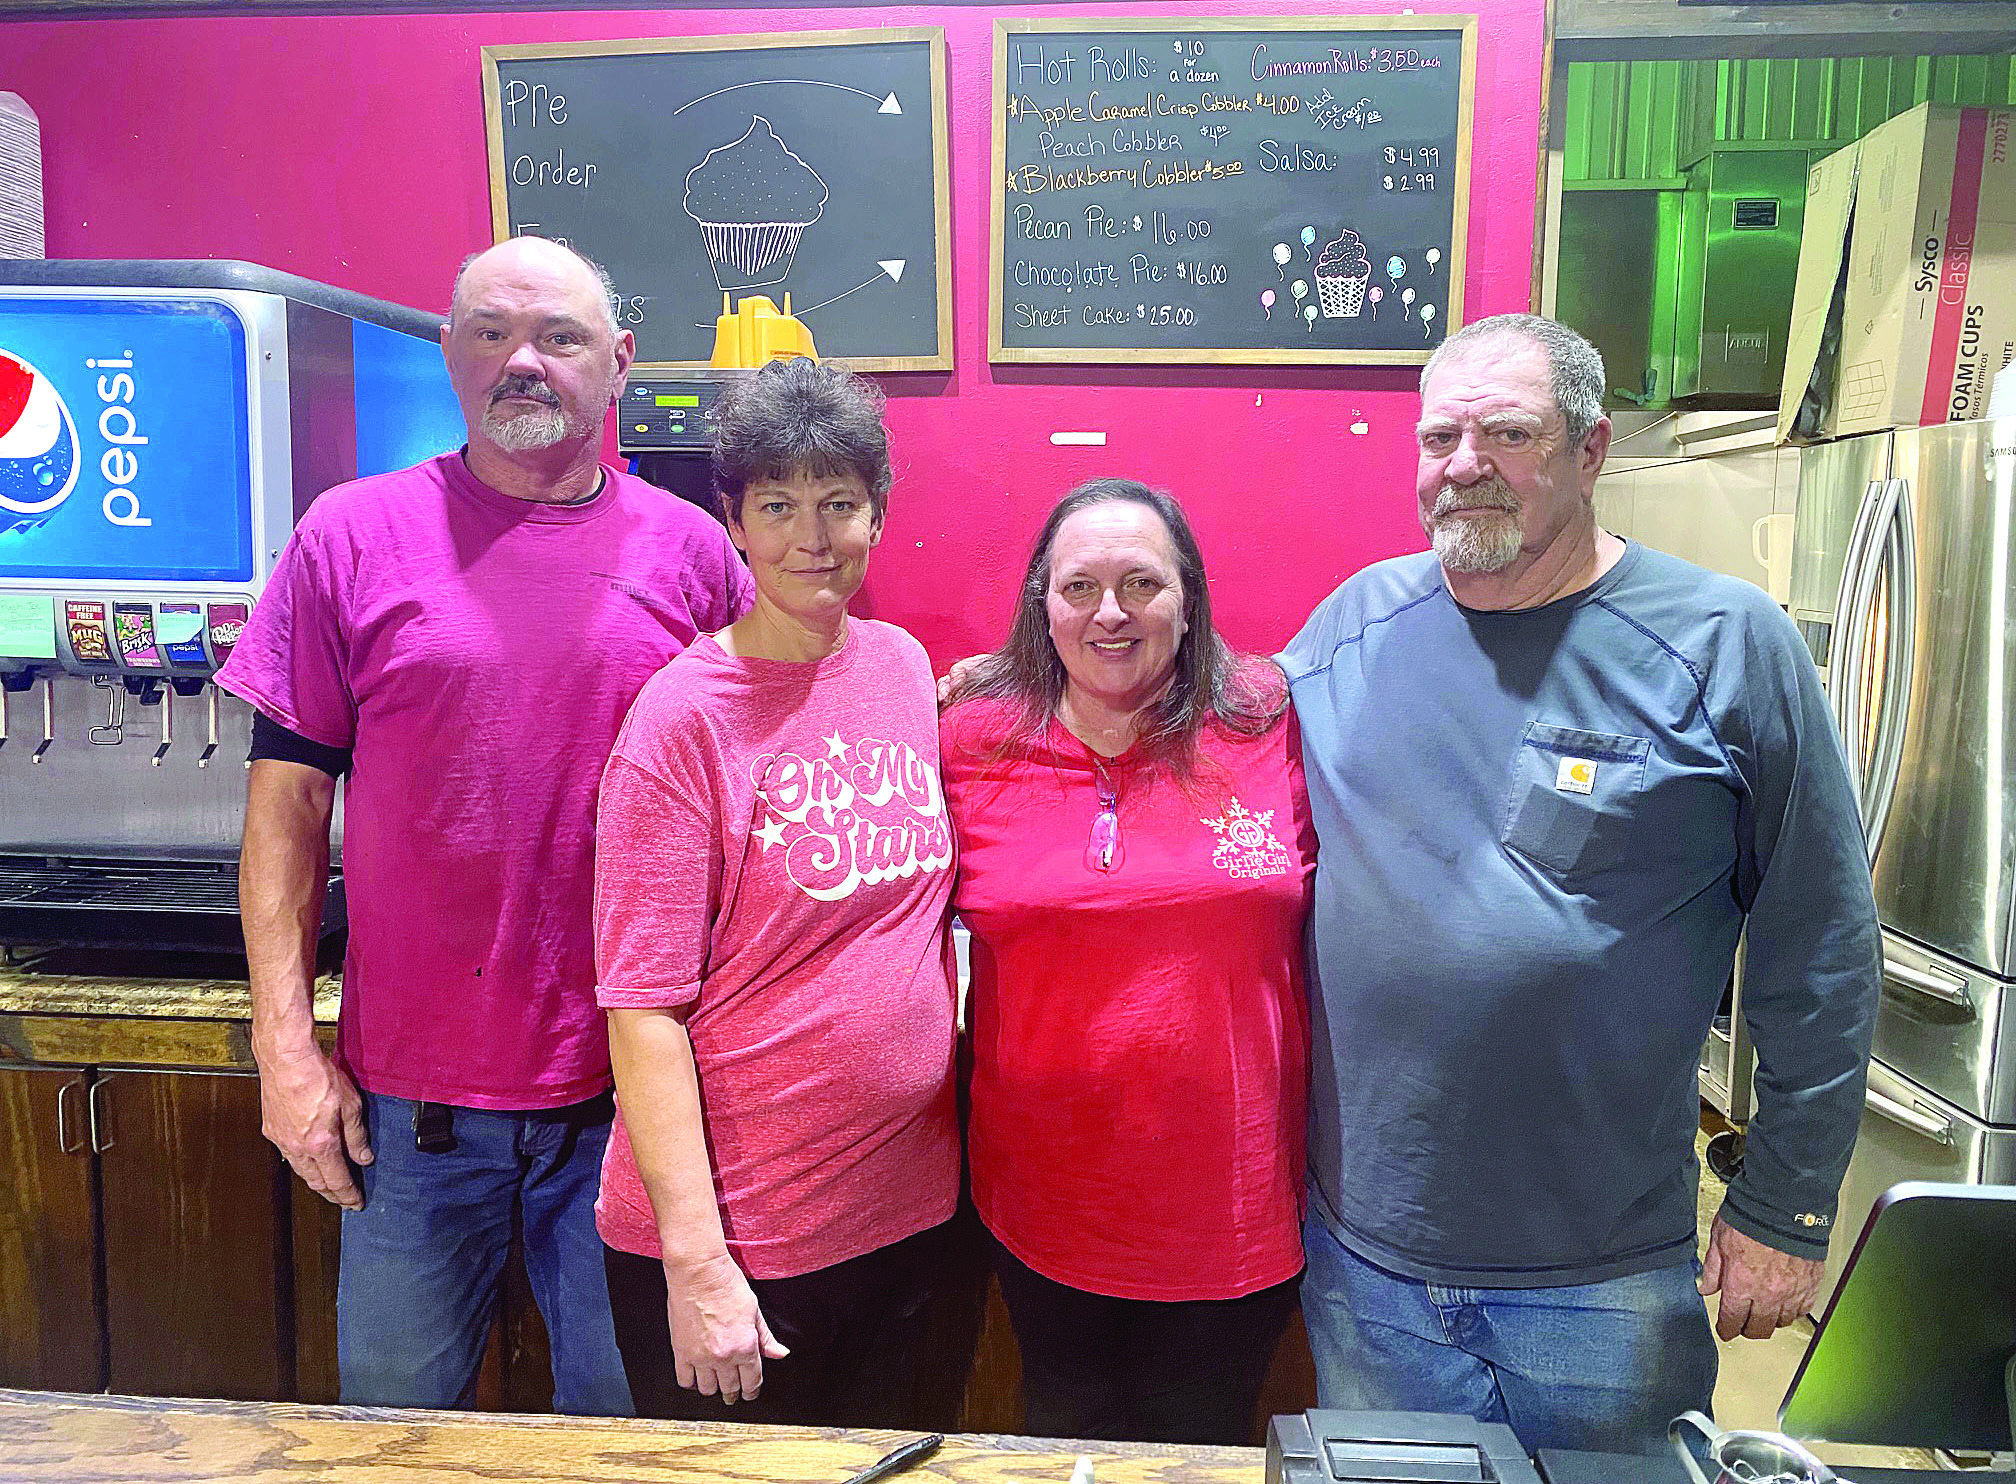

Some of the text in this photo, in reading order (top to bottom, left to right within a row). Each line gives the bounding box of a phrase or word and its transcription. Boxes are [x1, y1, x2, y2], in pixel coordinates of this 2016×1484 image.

[1016, 44, 1157, 84] Hot Rolls:
[1168, 68, 1219, 83] a dozen
[1251, 43, 1331, 82] Cinnamon
[1420, 55, 1441, 69] each
[504, 79, 569, 128] Pre
[1019, 93, 1087, 131] Apple
[1155, 93, 1199, 119] Crisp
[1304, 87, 1335, 115] Add
[1038, 131, 1106, 159] Peach
[1259, 139, 1338, 172] Salsa:
[512, 148, 598, 189] Order
[1019, 164, 1138, 195] Blackberry
[1142, 159, 1204, 189] Cobbler
[1013, 203, 1072, 240] Pecan
[1083, 204, 1127, 238] Pie:
[1013, 253, 1228, 288] Chocolate Pie: $16.00
[1914, 237, 1940, 293] Sysco
[1941, 231, 1972, 306] Classic
[1014, 303, 1072, 328] Sheet
[1083, 305, 1131, 326] Cake:
[1949, 305, 1984, 421] FOAM CUPS
[1973, 352, 1989, 394] Térmicos
[86, 358, 153, 527] pepsi
[68, 603, 103, 612] CAFFEINE
[76, 612, 95, 620] FREE
[71, 628, 105, 646] MUG
[121, 631, 152, 654] Brisk
[222, 622, 236, 633] Dr
[172, 643, 199, 652] pepsi
[750, 738, 943, 823] Oh My
[786, 804, 953, 902] Stars
[1213, 852, 1292, 869] Girlie Girl
[1229, 864, 1287, 880] Originals
